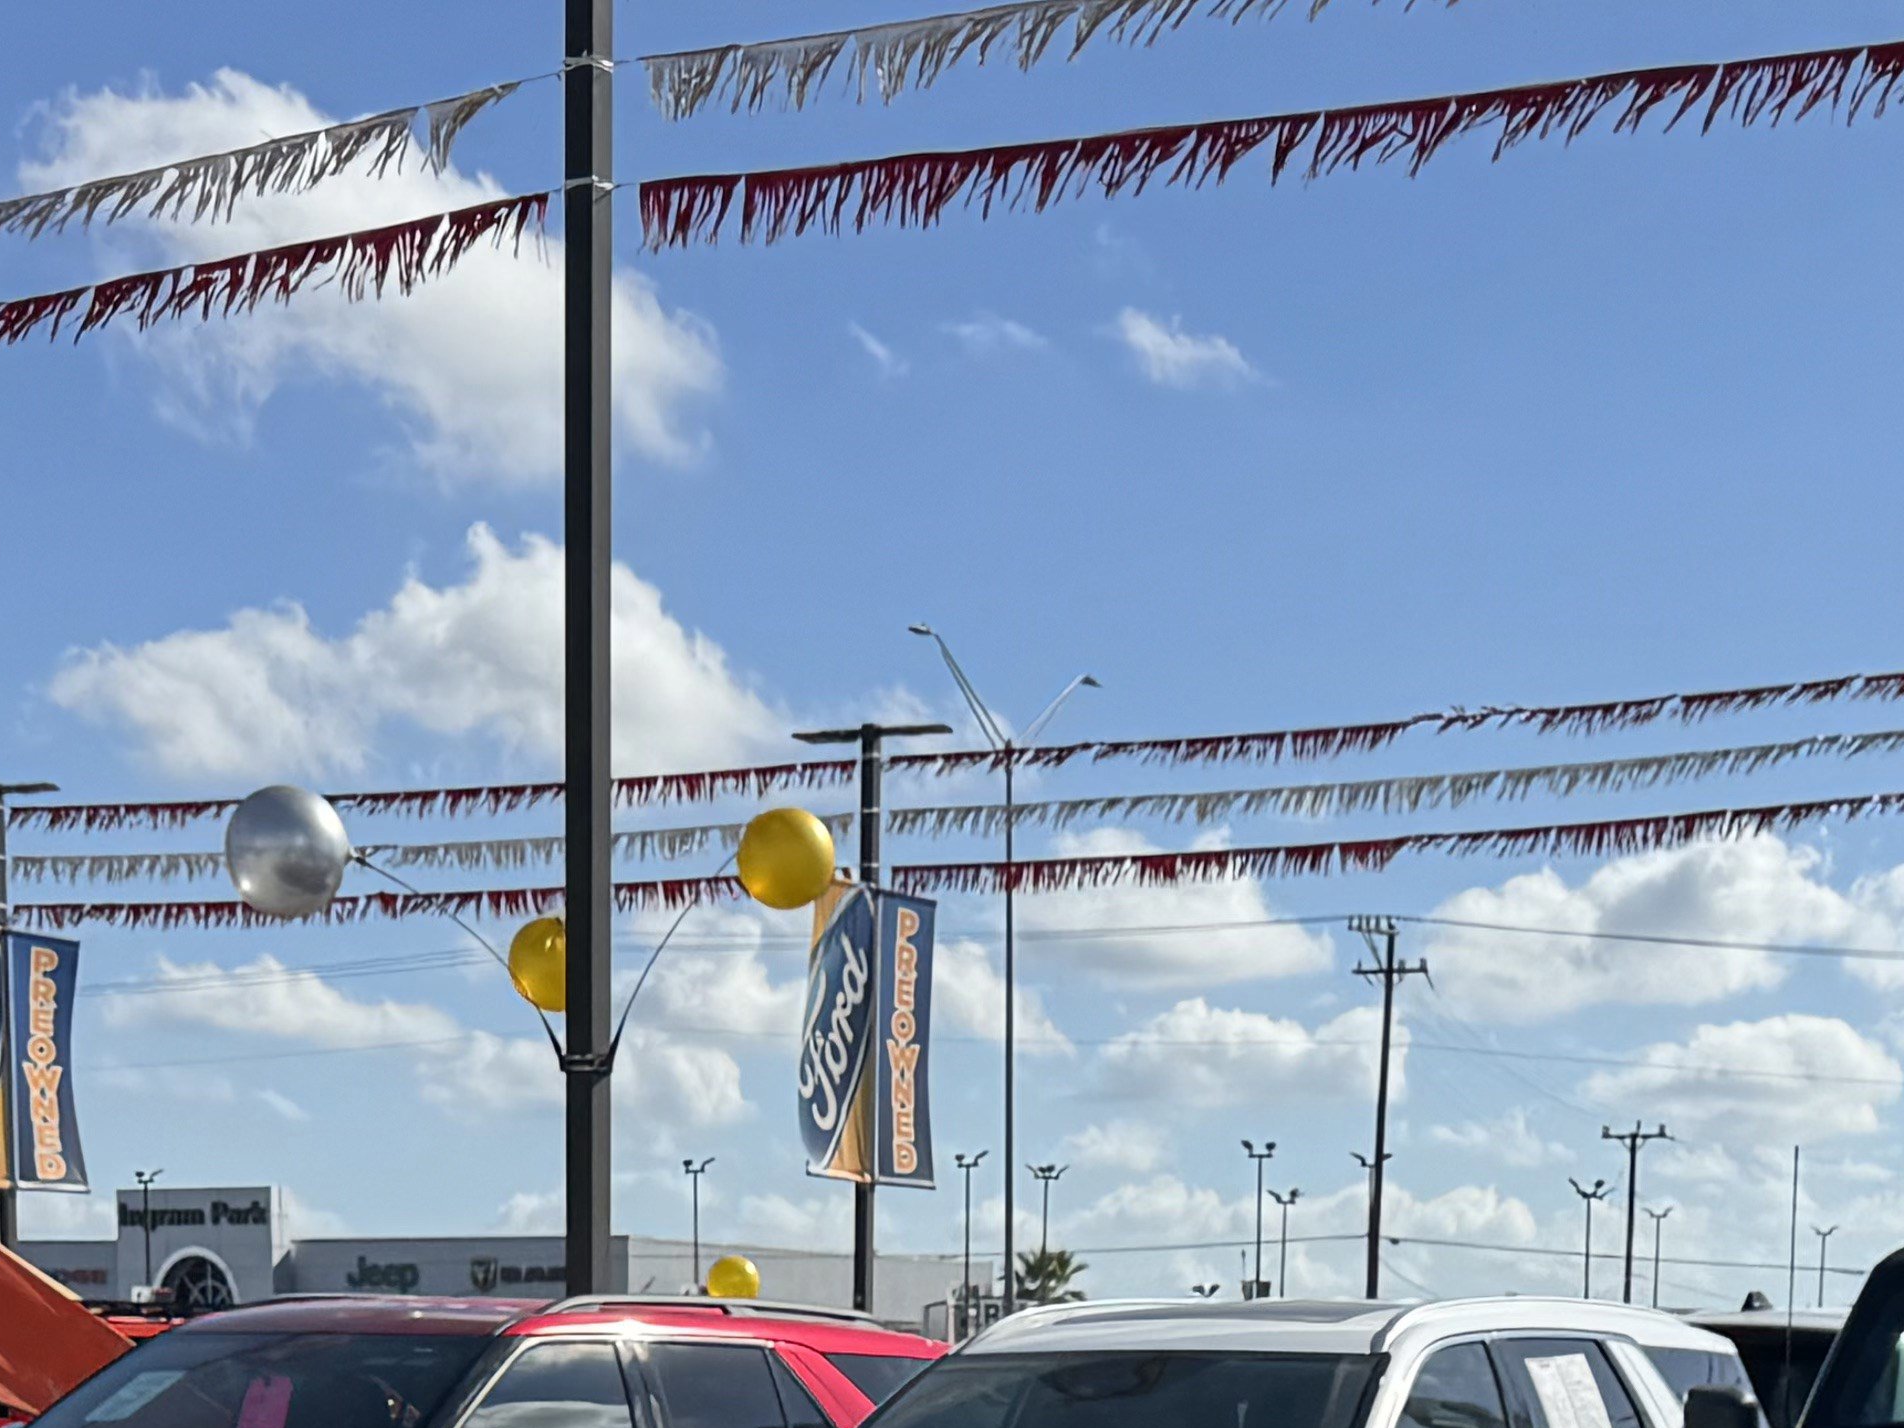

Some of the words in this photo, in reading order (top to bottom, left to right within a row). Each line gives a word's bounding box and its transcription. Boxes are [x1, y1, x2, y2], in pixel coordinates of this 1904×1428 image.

[22, 946, 67, 1180] PREOWNED
[799, 932, 869, 1131] Ford
[886, 906, 920, 1175] PREOWNED
[210, 1200, 268, 1225] Park
[347, 1255, 420, 1293] Jeep
